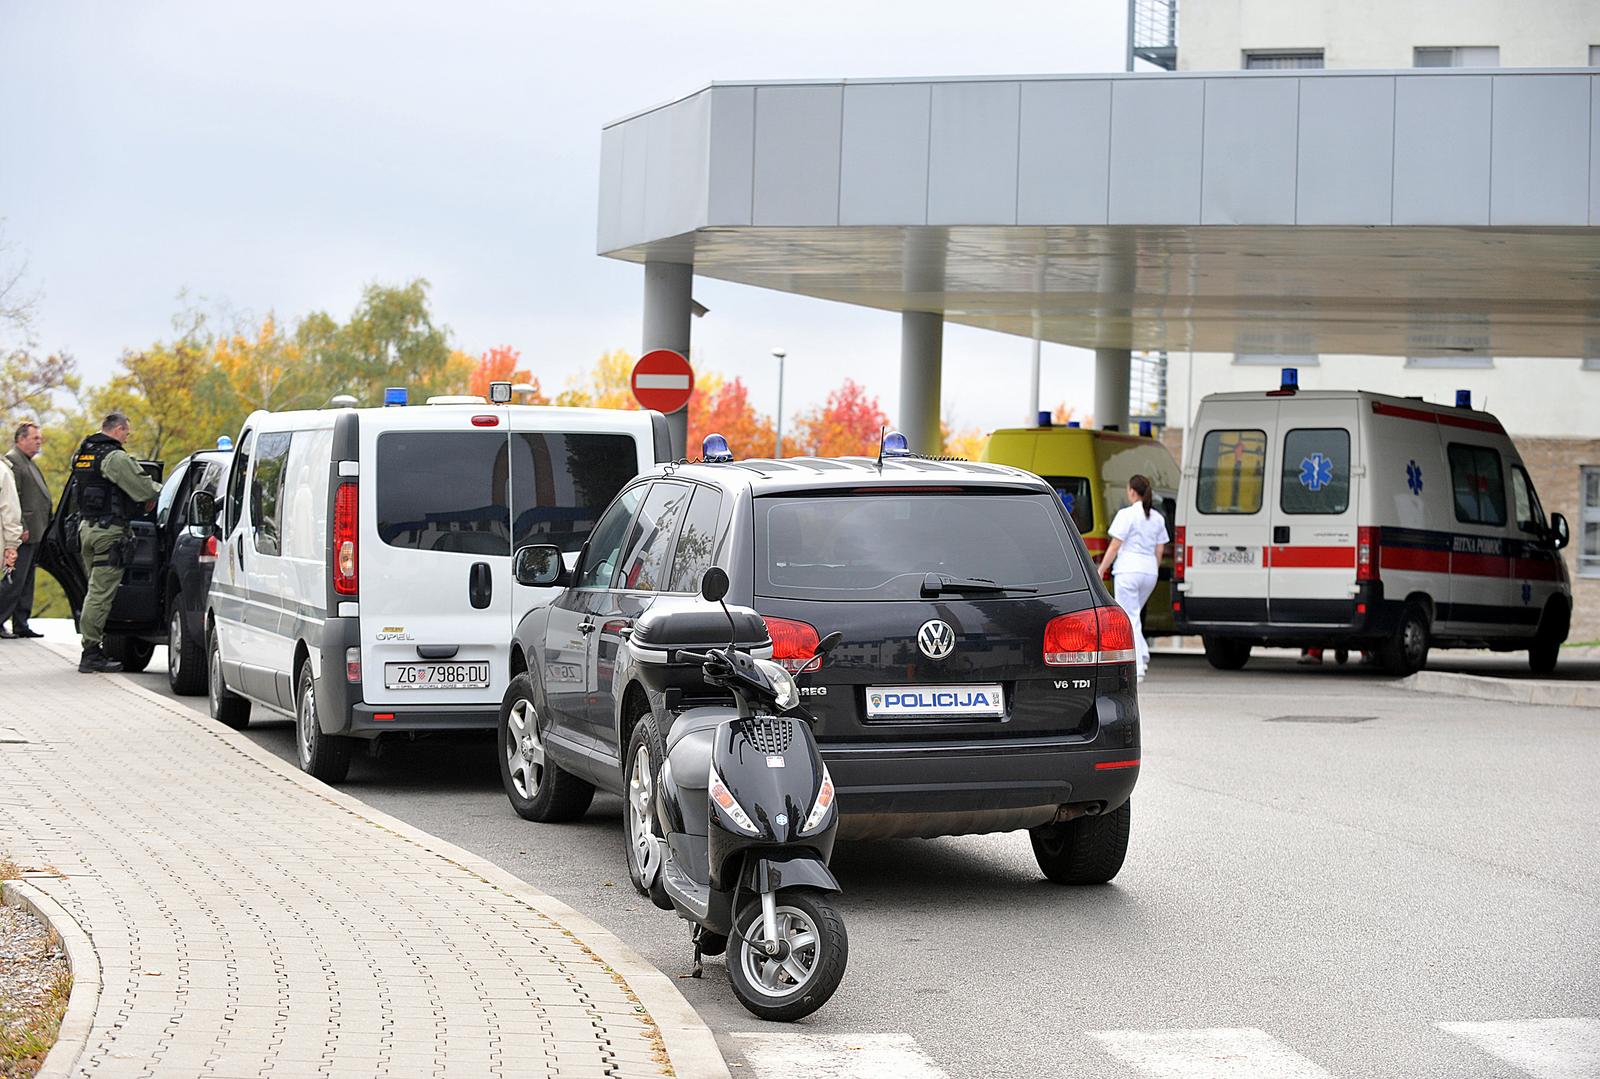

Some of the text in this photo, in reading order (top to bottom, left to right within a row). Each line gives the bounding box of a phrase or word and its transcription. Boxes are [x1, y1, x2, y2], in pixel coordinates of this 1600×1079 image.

[376, 633, 415, 641] OPEL
[397, 666, 416, 683] ZG
[1053, 679, 1091, 689] V6 TDI
[884, 692, 990, 708] POLICIJA
